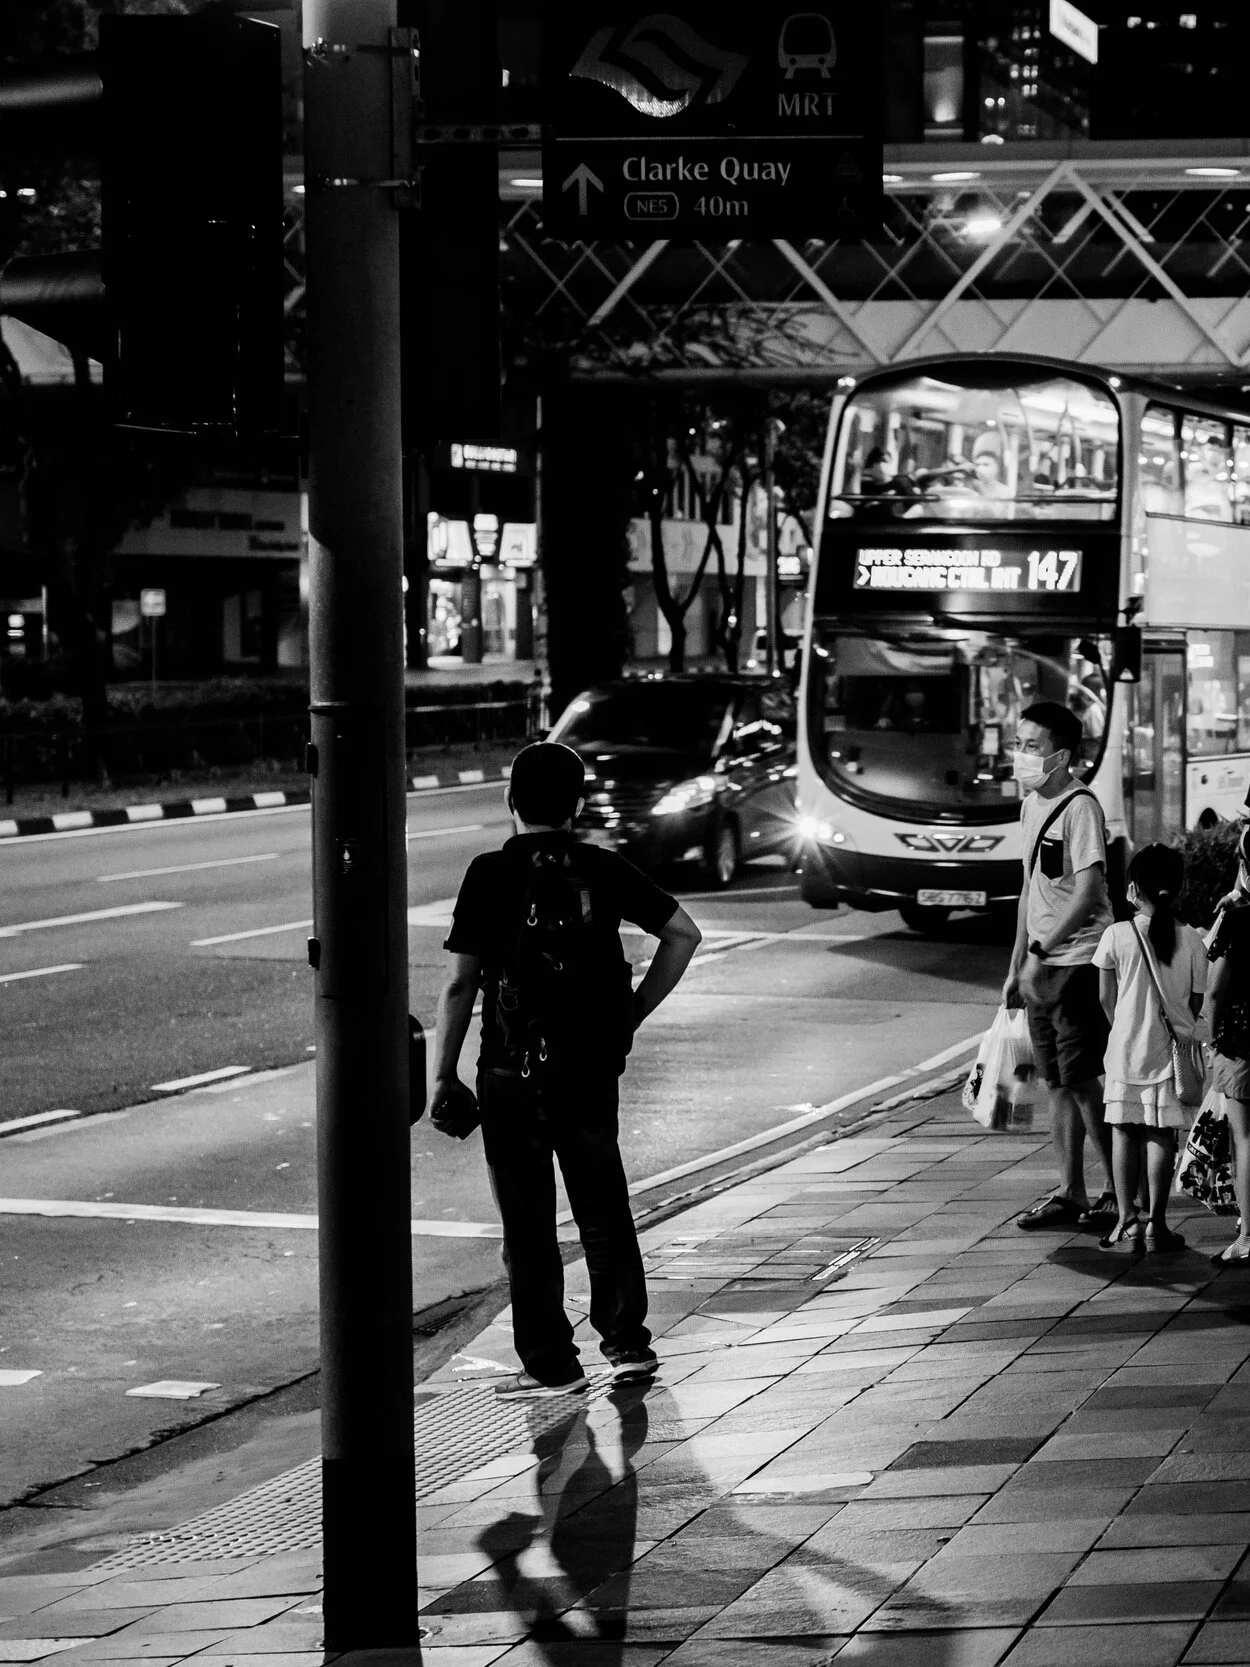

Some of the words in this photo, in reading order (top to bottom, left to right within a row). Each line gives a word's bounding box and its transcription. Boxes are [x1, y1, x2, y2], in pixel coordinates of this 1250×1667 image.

[777, 93, 836, 116] MRT
[622, 156, 709, 181] Clarke
[720, 156, 791, 186] Quay
[637, 199, 668, 214] NE5
[694, 195, 748, 216] 40m
[1027, 550, 1078, 590] 147
